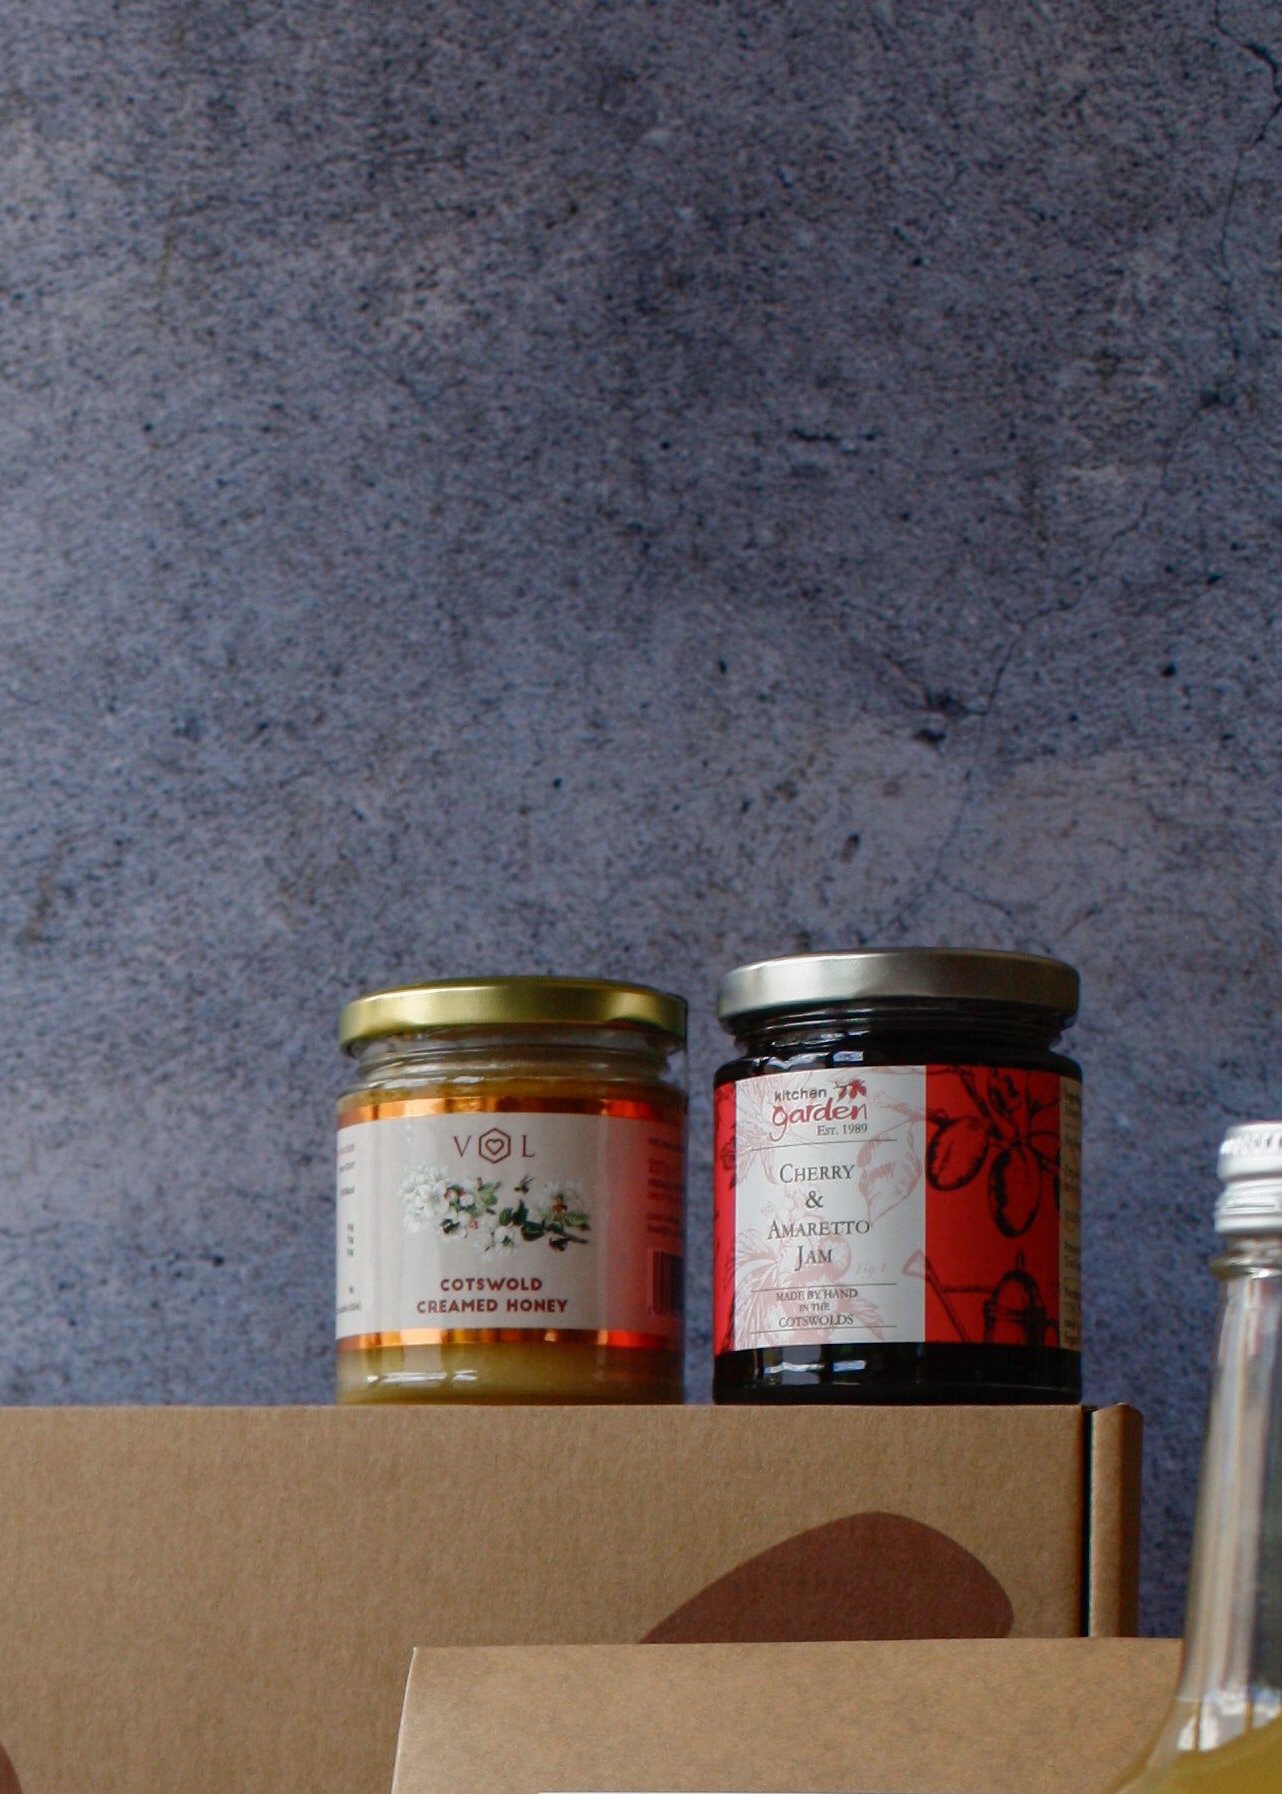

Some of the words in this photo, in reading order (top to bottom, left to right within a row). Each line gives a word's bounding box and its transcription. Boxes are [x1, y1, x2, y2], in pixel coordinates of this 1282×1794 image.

[774, 1088, 827, 1102] kitchen
[769, 1097, 868, 1142] garden
[842, 1123, 868, 1135] 1989
[779, 1163, 855, 1183] CHERRY
[805, 1190, 824, 1208] &
[767, 1219, 870, 1240] AMARETTO
[794, 1245, 832, 1271] JAM
[440, 1277, 543, 1292] COTSWOLD
[776, 1290, 805, 1301] MADE
[807, 1289, 821, 1300] BY
[823, 1288, 858, 1299] HAND
[417, 1299, 498, 1313] CREAMED
[506, 1299, 568, 1313] HONEY
[799, 1303, 810, 1312] IN
[810, 1302, 830, 1311] THE
[778, 1314, 854, 1328] COTSWOLDS
